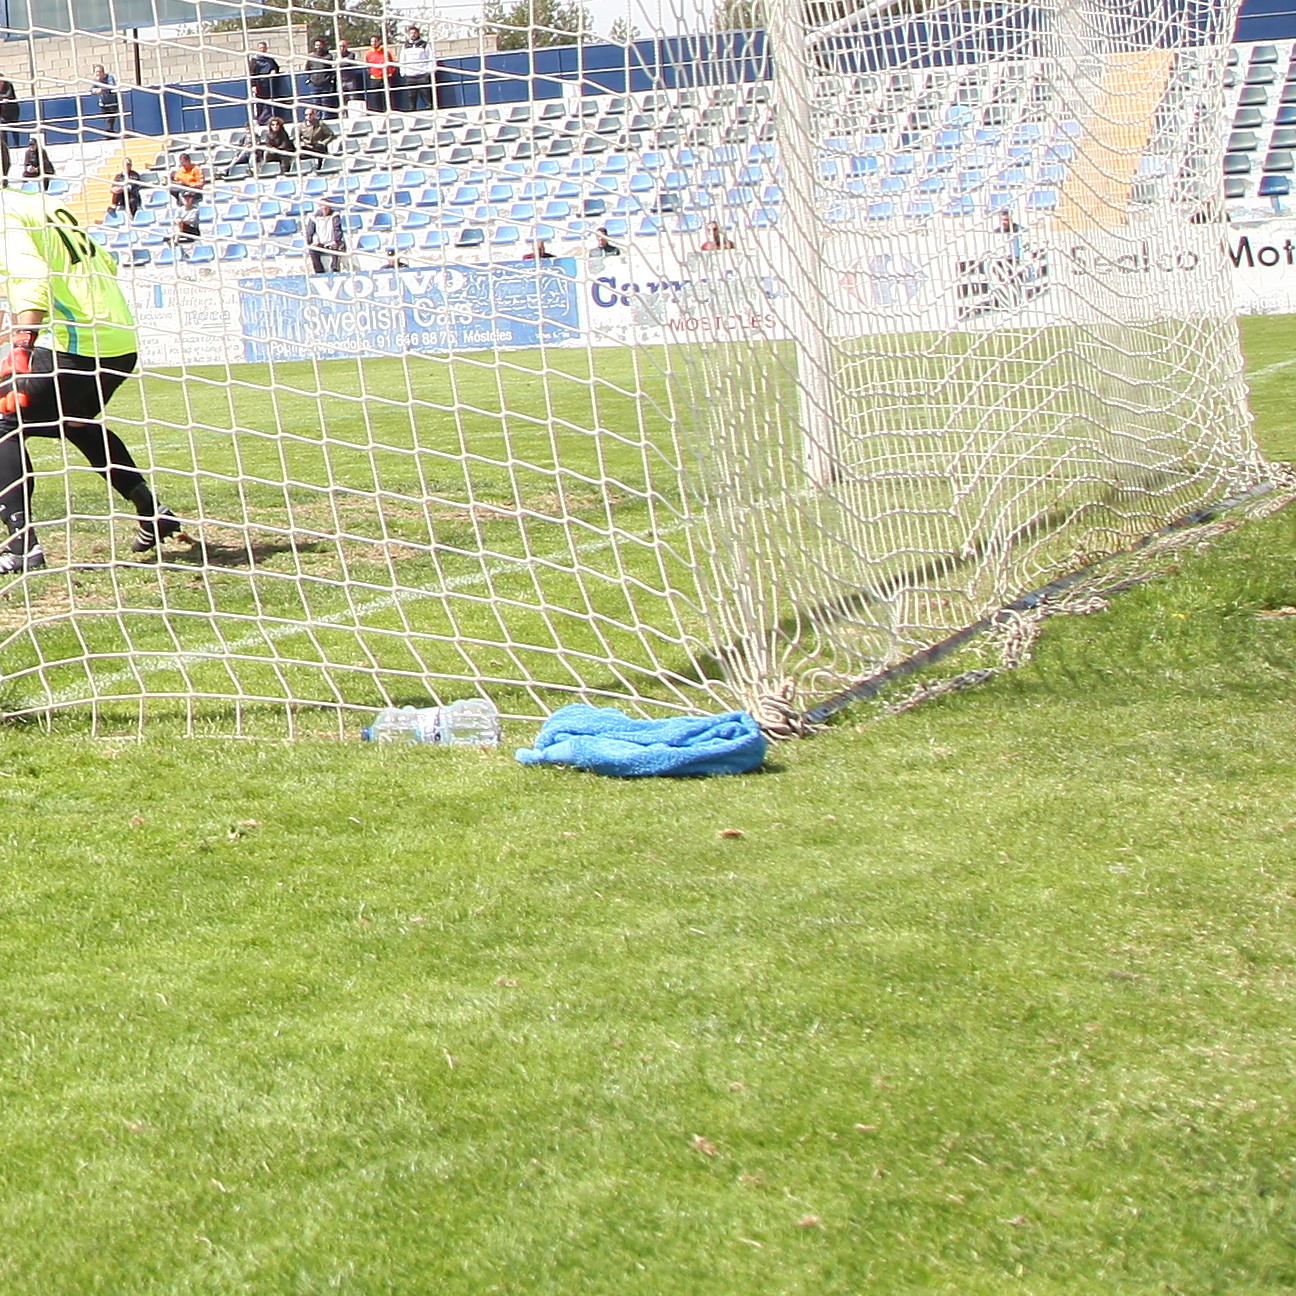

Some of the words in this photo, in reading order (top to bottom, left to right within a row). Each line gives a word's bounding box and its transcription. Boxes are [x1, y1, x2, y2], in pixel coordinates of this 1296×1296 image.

[309, 268, 465, 301] VOLVO
[303, 303, 406, 333] Swedish
[414, 297, 474, 326] Cars
